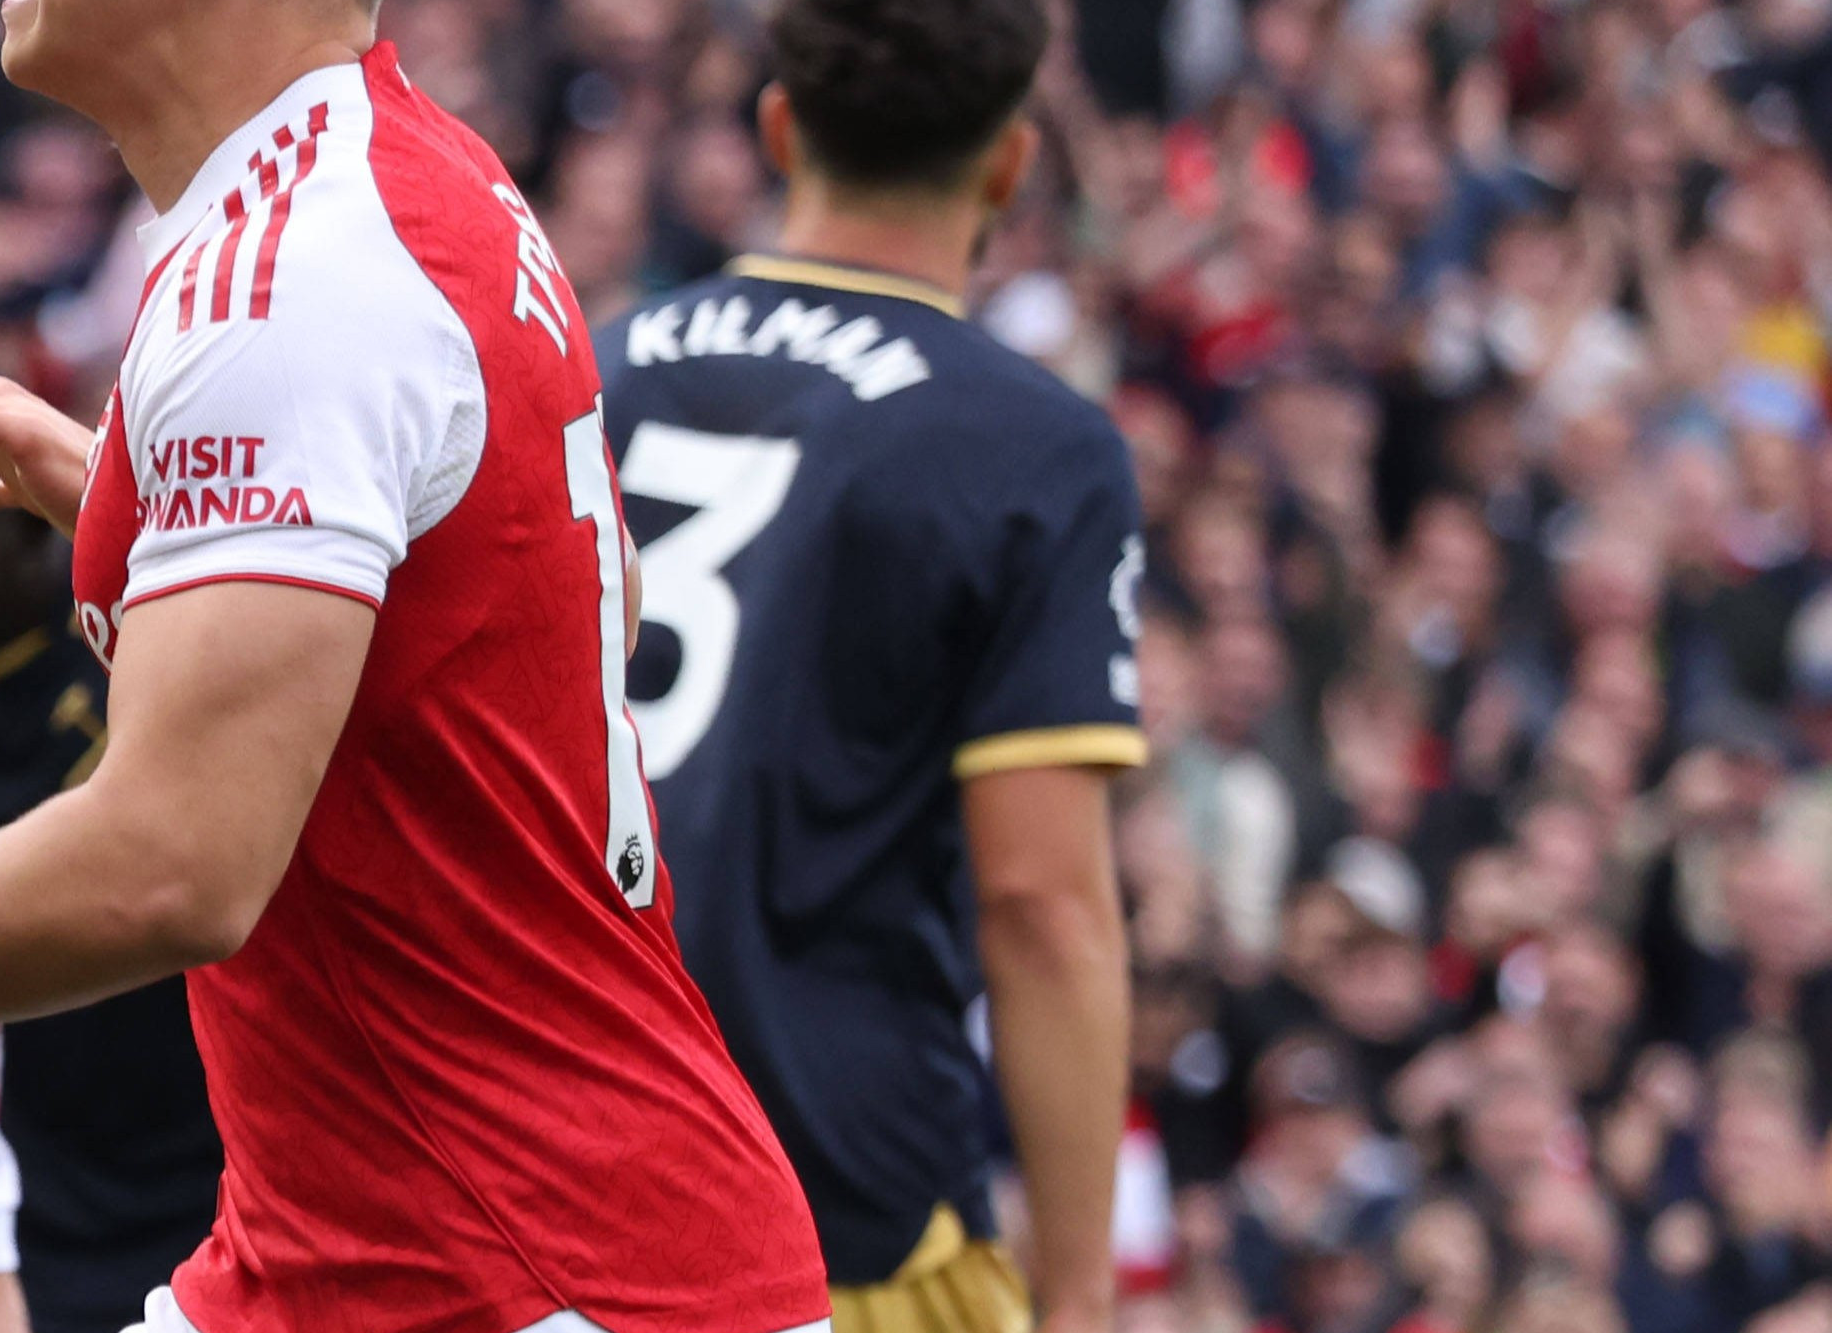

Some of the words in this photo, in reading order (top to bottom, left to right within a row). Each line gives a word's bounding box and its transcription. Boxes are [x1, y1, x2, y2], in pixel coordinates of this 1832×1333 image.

[149, 436, 264, 483] VISIT
[628, 295, 931, 402] KILMAN
[563, 406, 657, 910] 1
[620, 420, 801, 782] 3
